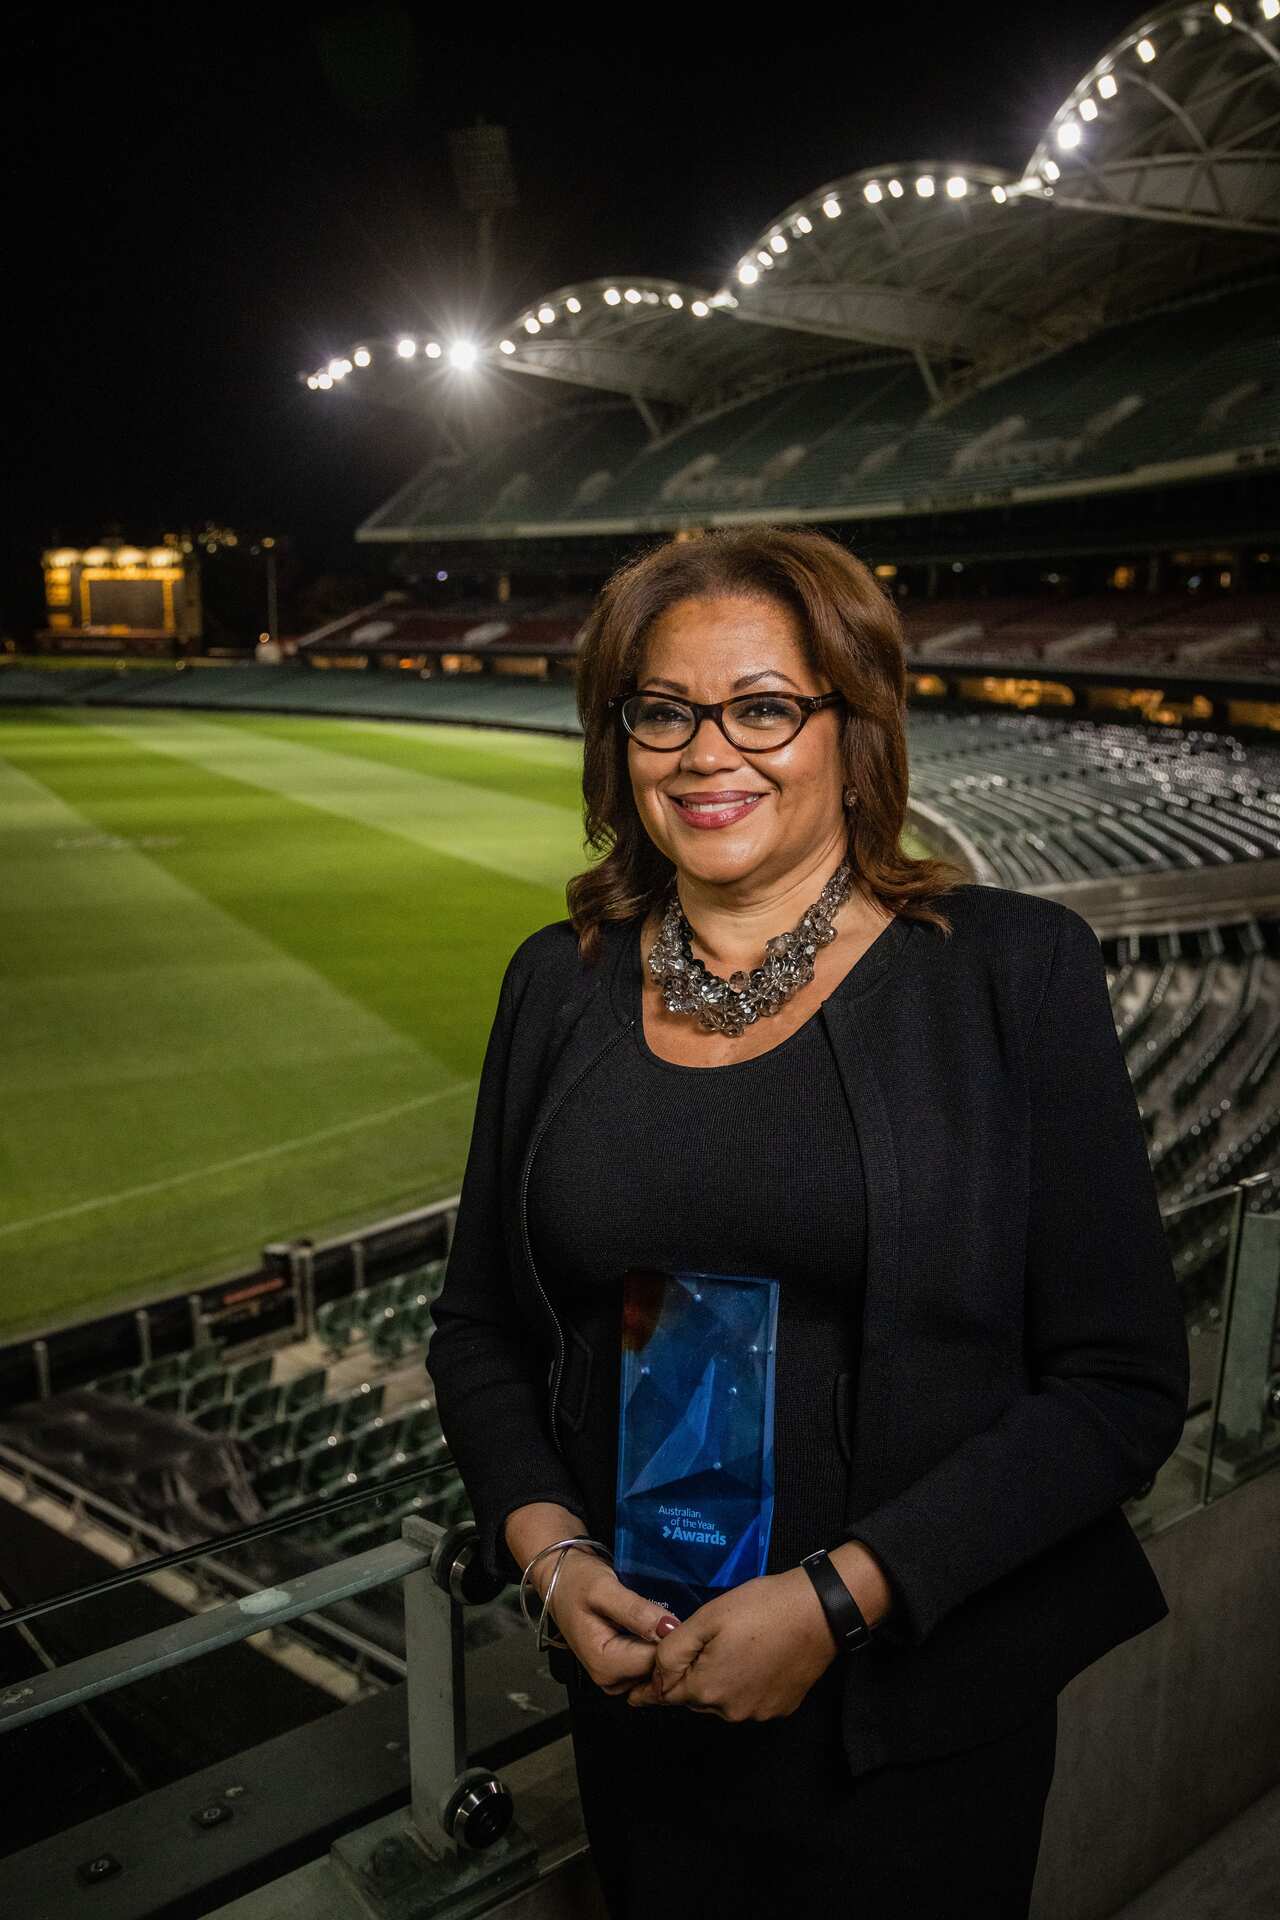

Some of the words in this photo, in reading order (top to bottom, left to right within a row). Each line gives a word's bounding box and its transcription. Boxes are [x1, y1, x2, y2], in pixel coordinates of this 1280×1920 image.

[658, 1505, 702, 1518] Australian
[670, 1517, 681, 1526] of
[682, 1519, 697, 1528] the
[697, 1520, 716, 1530] Year
[671, 1527, 727, 1545] Awards
